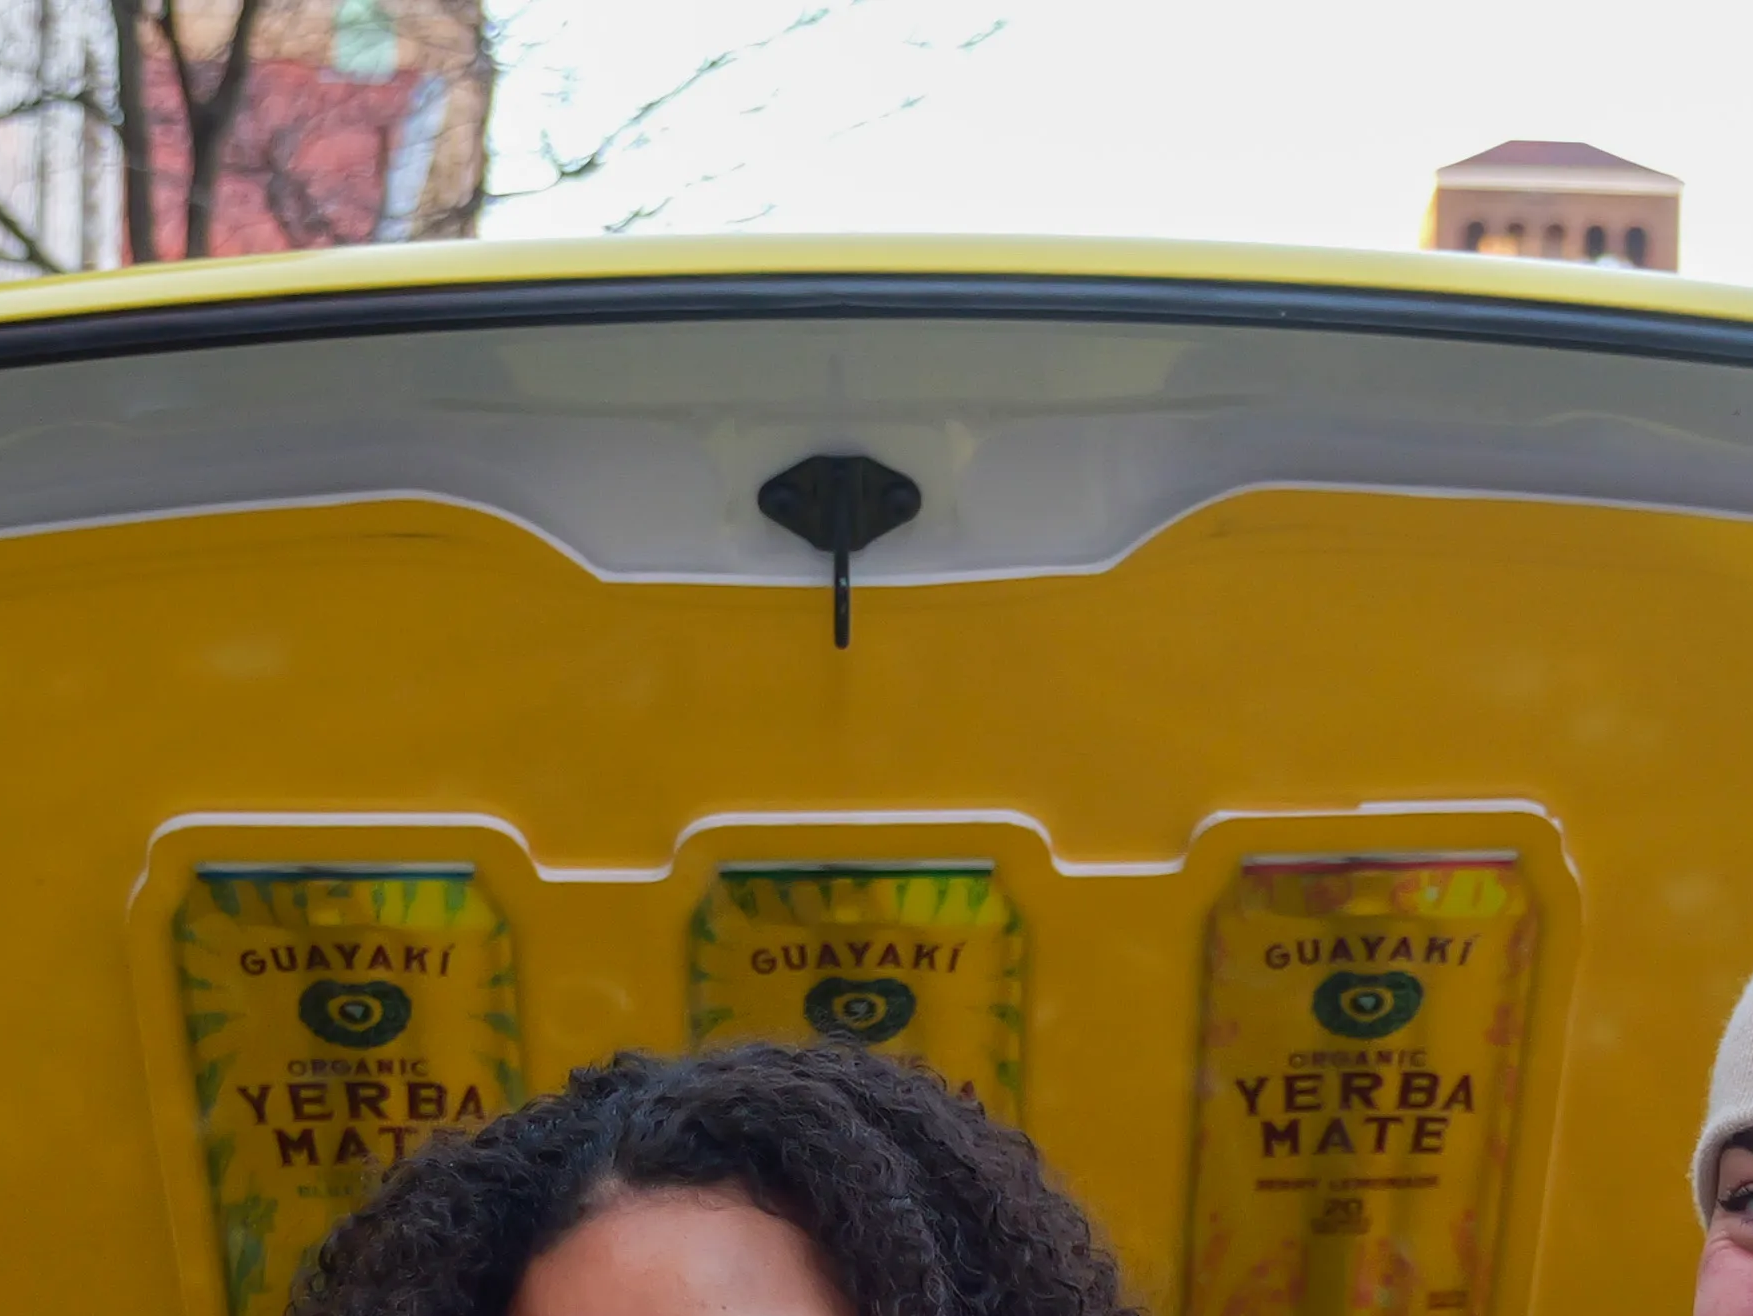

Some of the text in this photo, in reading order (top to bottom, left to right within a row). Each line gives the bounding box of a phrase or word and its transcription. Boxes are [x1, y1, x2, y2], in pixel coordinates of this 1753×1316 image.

[287, 1057, 430, 1077] ORGANIC
[237, 1081, 486, 1125] YERBA
[1236, 1072, 1474, 1117] YERBA
[273, 1126, 467, 1168] MAT
[1261, 1115, 1450, 1157] MATE
